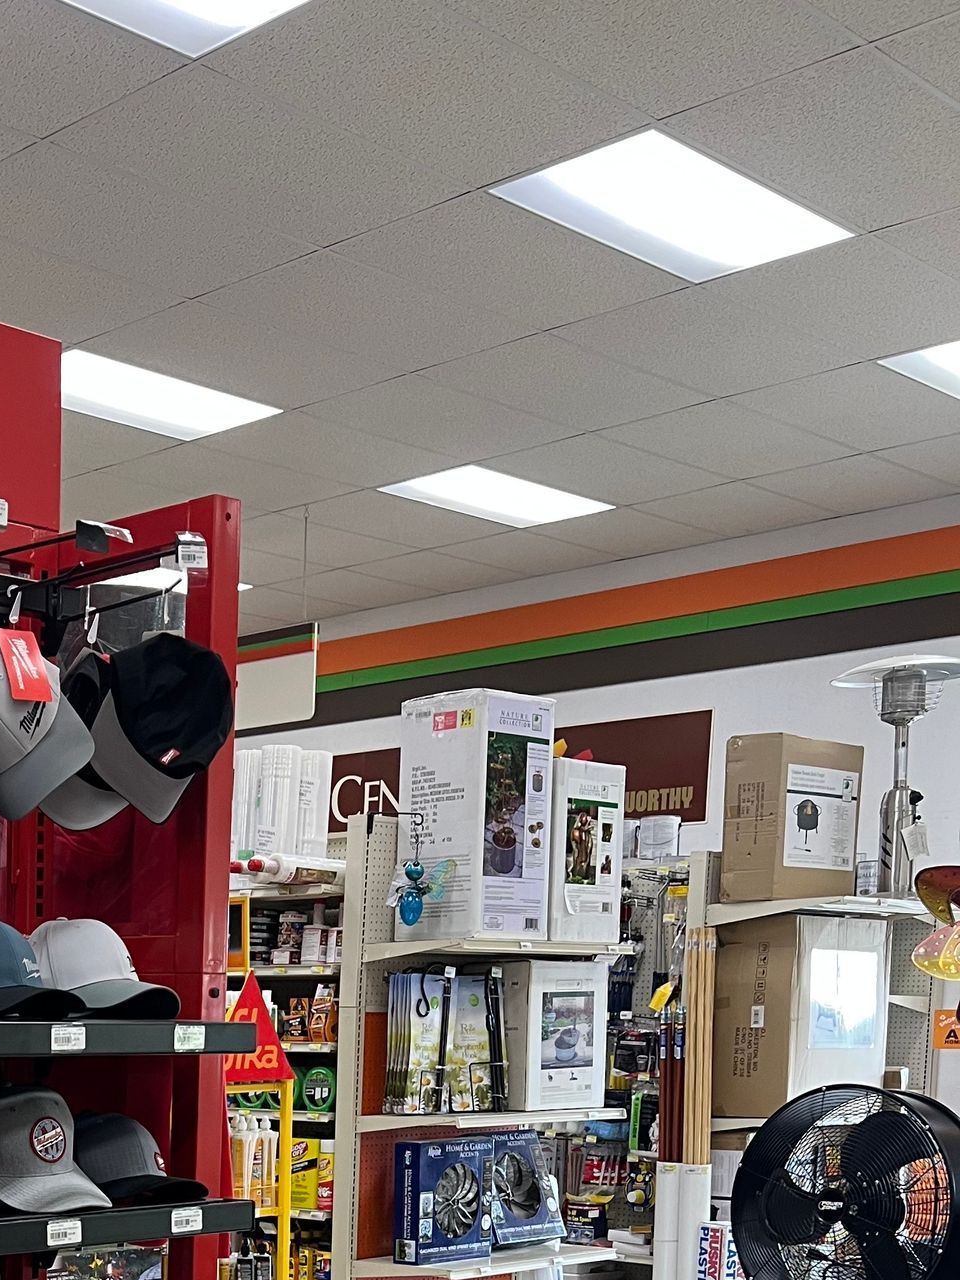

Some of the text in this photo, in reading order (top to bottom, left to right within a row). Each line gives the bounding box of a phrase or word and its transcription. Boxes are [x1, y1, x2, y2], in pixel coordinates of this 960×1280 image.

[445, 1142, 492, 1152] HOME & GARDEN
[708, 1228, 720, 1280] HUSKY
